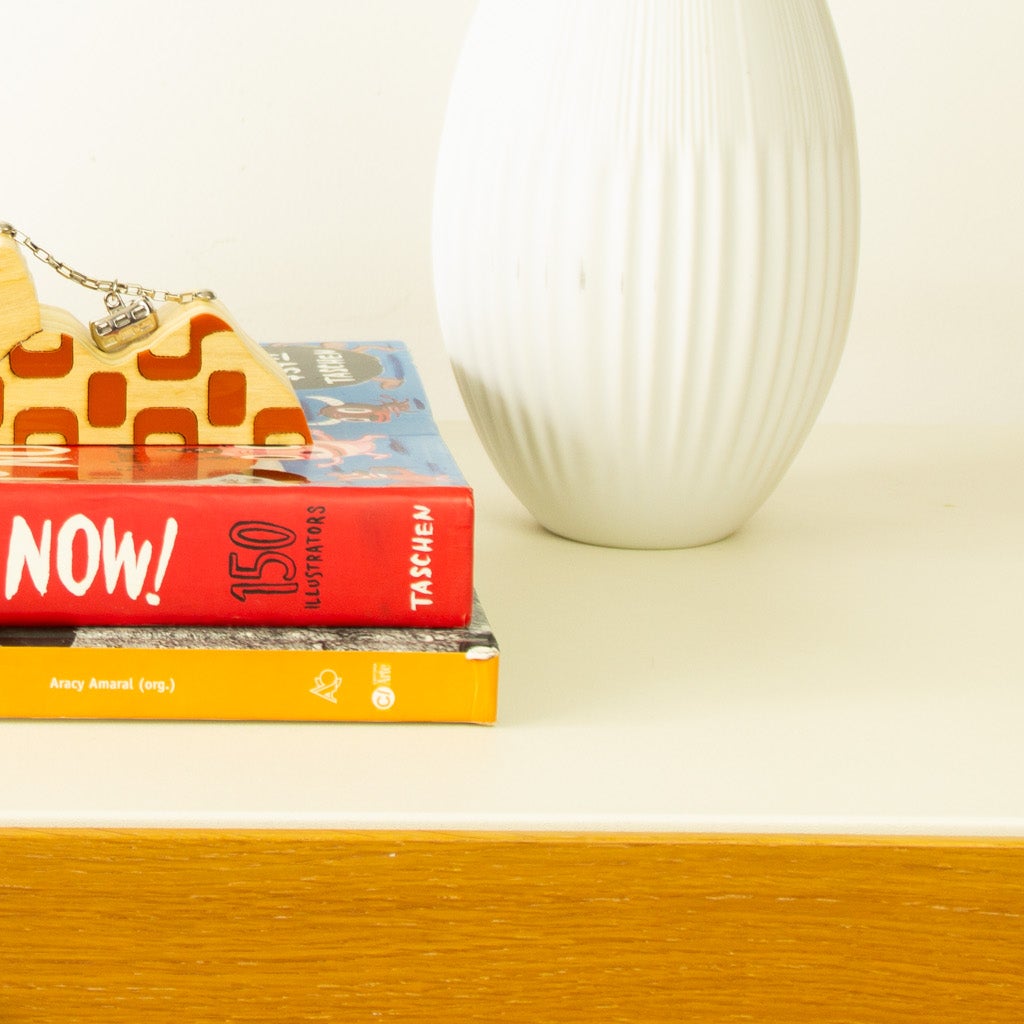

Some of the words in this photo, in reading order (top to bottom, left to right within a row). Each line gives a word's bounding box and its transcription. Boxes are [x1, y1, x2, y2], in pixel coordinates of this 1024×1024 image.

[314, 349, 356, 384] TASCHEN
[4, 513, 179, 606] NOW!
[228, 520, 299, 603] 150
[304, 505, 326, 610] ILLUSTRATORS
[409, 504, 435, 611] TASCHEN
[49, 677, 85, 693] Aracy
[88, 677, 134, 691] Amaral
[138, 677, 176, 694] (org.)
